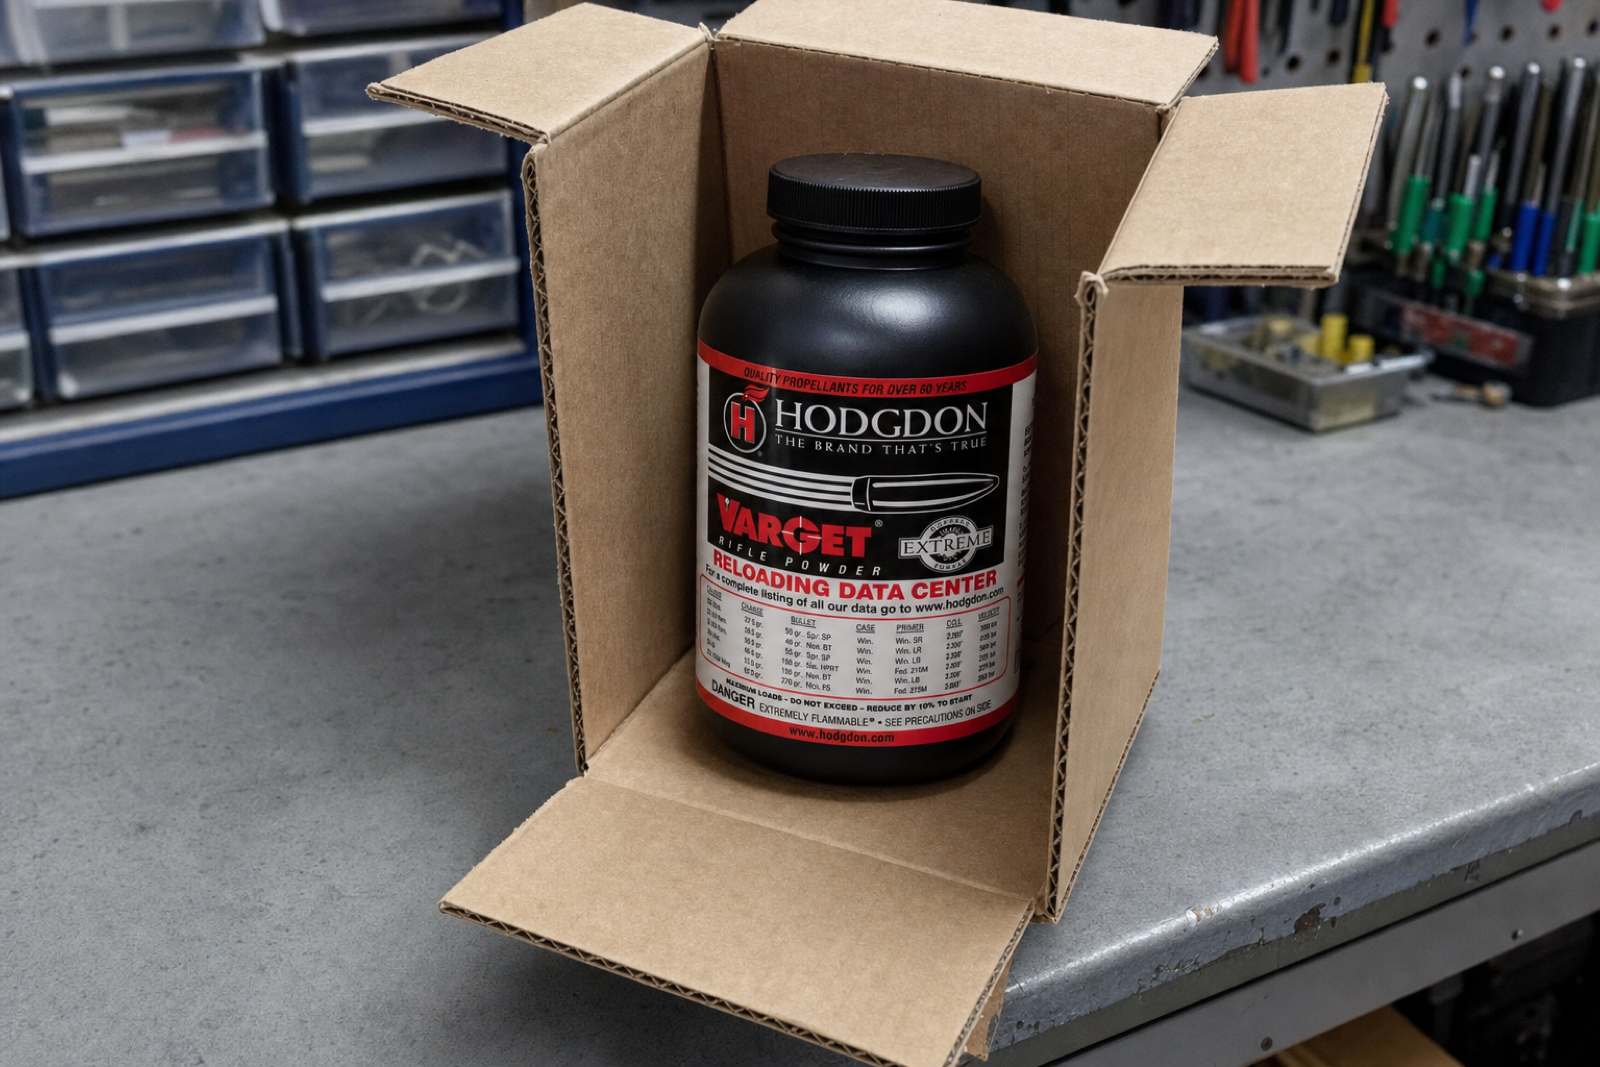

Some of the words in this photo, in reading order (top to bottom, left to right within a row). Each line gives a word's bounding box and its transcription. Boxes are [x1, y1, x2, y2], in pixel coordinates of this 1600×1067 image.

[744, 367, 781, 384] QUALITY
[783, 375, 858, 395] PROPELLANTS
[862, 383, 884, 395] FOR
[887, 384, 917, 395] OVER
[920, 384, 933, 394] 60
[936, 380, 968, 393] YEARS
[731, 401, 755, 444] H
[775, 398, 988, 438] HODGDON
[775, 433, 805, 448] THE
[815, 441, 872, 454] BRAND
[882, 443, 942, 455] THAT'S
[951, 437, 987, 451] TRUE
[717, 493, 872, 558] VARGET
[904, 530, 990, 554] EXTREME
[719, 535, 767, 561] RIFLE
[785, 557, 881, 576] POWDER
[705, 563, 716, 577] For
[716, 573, 721, 581] a
[721, 575, 759, 596] complete
[761, 589, 793, 606] listing
[796, 598, 808, 607] of
[810, 599, 824, 610] all
[827, 603, 848, 612] our
[851, 603, 877, 614] data
[881, 605, 896, 616] go
[899, 604, 912, 613] to
[915, 587, 1004, 613] www.hodgdon.com
[714, 549, 830, 597] RELOADING
[839, 582, 905, 600] DATA
[911, 569, 997, 600] CENTER
[856, 623, 875, 631] CASE
[711, 679, 755, 709] DANGER
[759, 703, 808, 721] EXTREMELY
[885, 718, 902, 727] SEE
[905, 709, 963, 726] PRECAUTIONS
[965, 706, 976, 716] ON
[976, 699, 992, 713] SIDE
[758, 690, 782, 702] LOADS
[790, 697, 802, 705] DO
[804, 699, 822, 708] NOT
[824, 702, 858, 711] EXCEED
[919, 702, 935, 710] 10%
[950, 694, 973, 705] START
[855, 687, 872, 695] Win.
[790, 726, 894, 743] www.hodgdon.com
